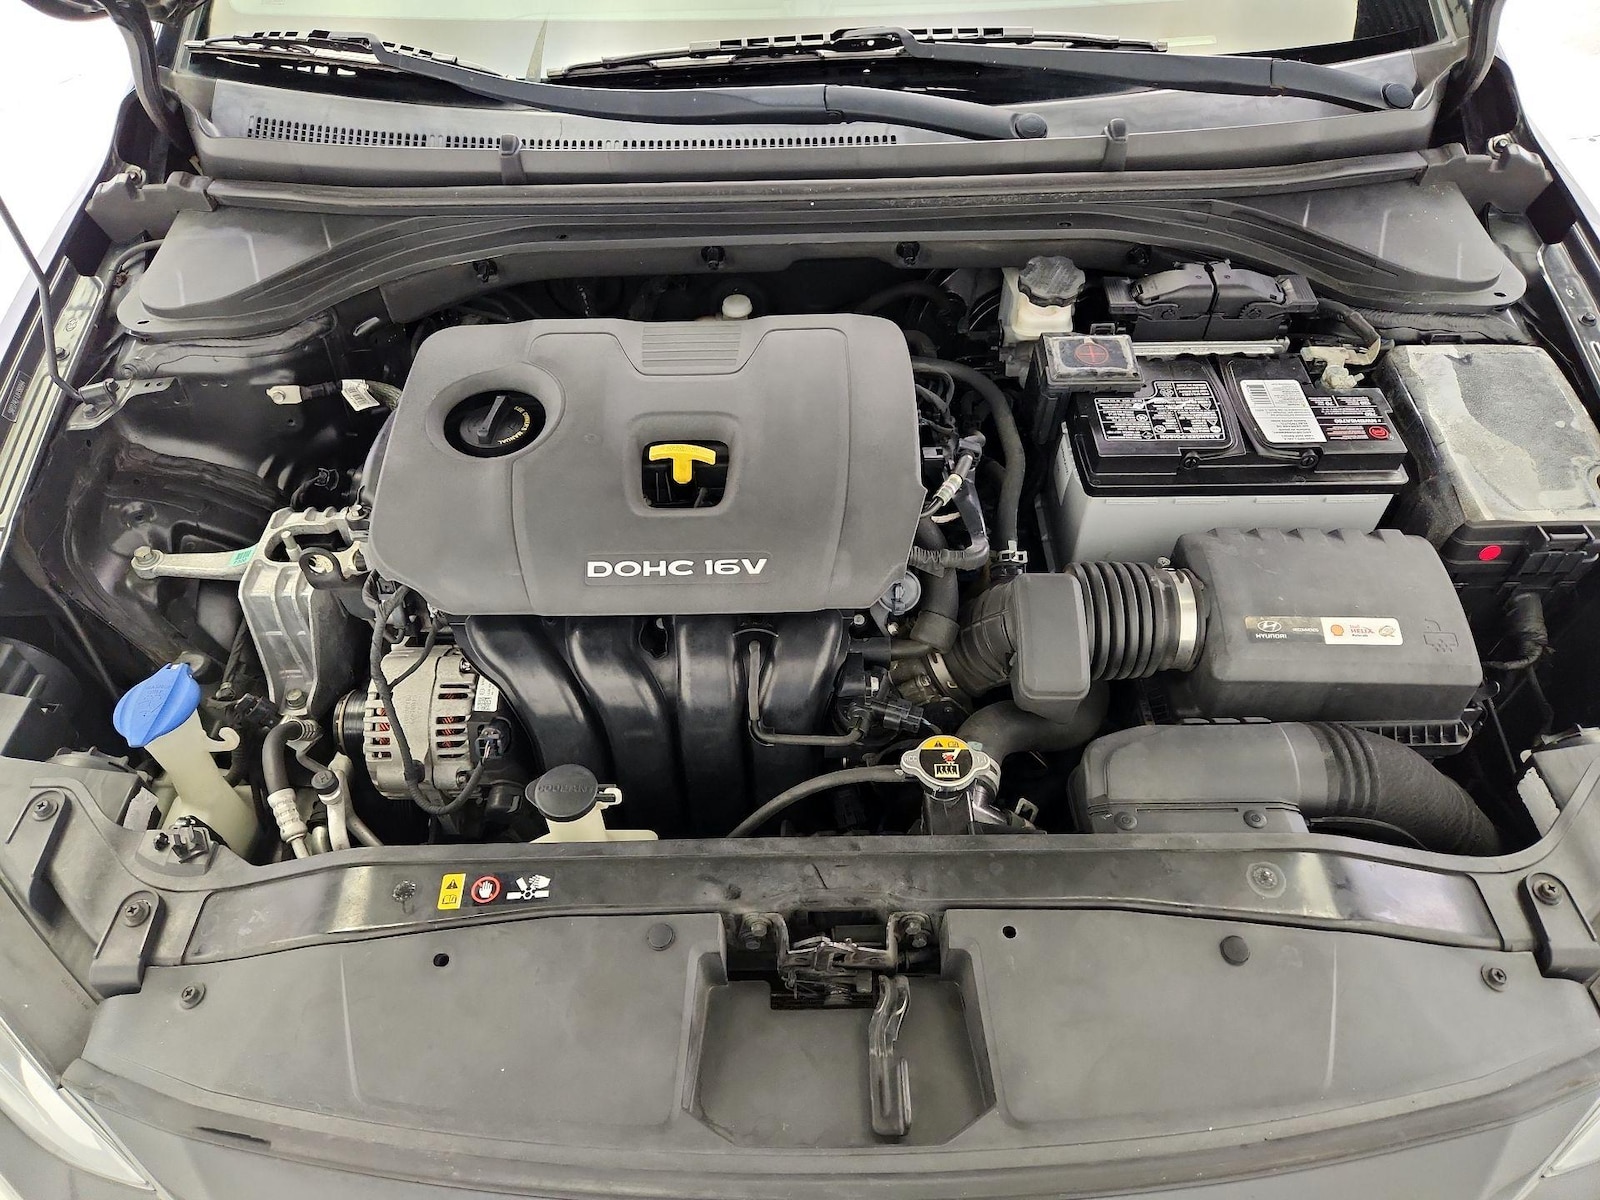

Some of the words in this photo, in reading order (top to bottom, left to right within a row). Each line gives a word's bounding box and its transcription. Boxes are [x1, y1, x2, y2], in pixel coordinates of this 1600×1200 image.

[498, 431, 523, 444] MANUAL
[586, 559, 695, 578] DOHC
[704, 558, 768, 576] 16V
